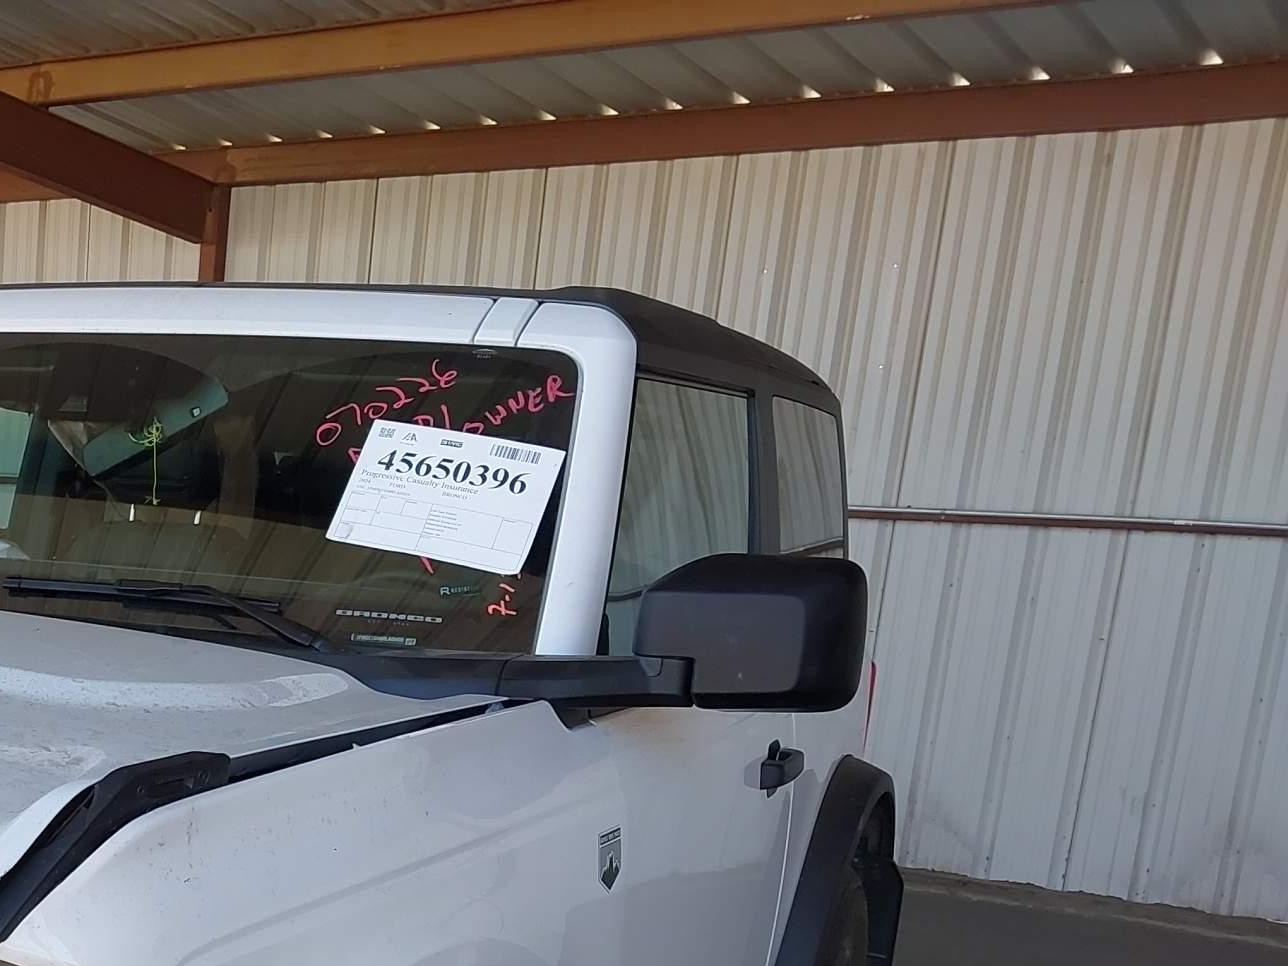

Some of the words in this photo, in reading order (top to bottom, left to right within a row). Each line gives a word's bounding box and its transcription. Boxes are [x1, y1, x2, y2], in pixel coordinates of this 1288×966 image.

[377, 449, 532, 495] 45650396
[406, 476, 439, 489] Casualty
[441, 481, 480, 495] Insurance
